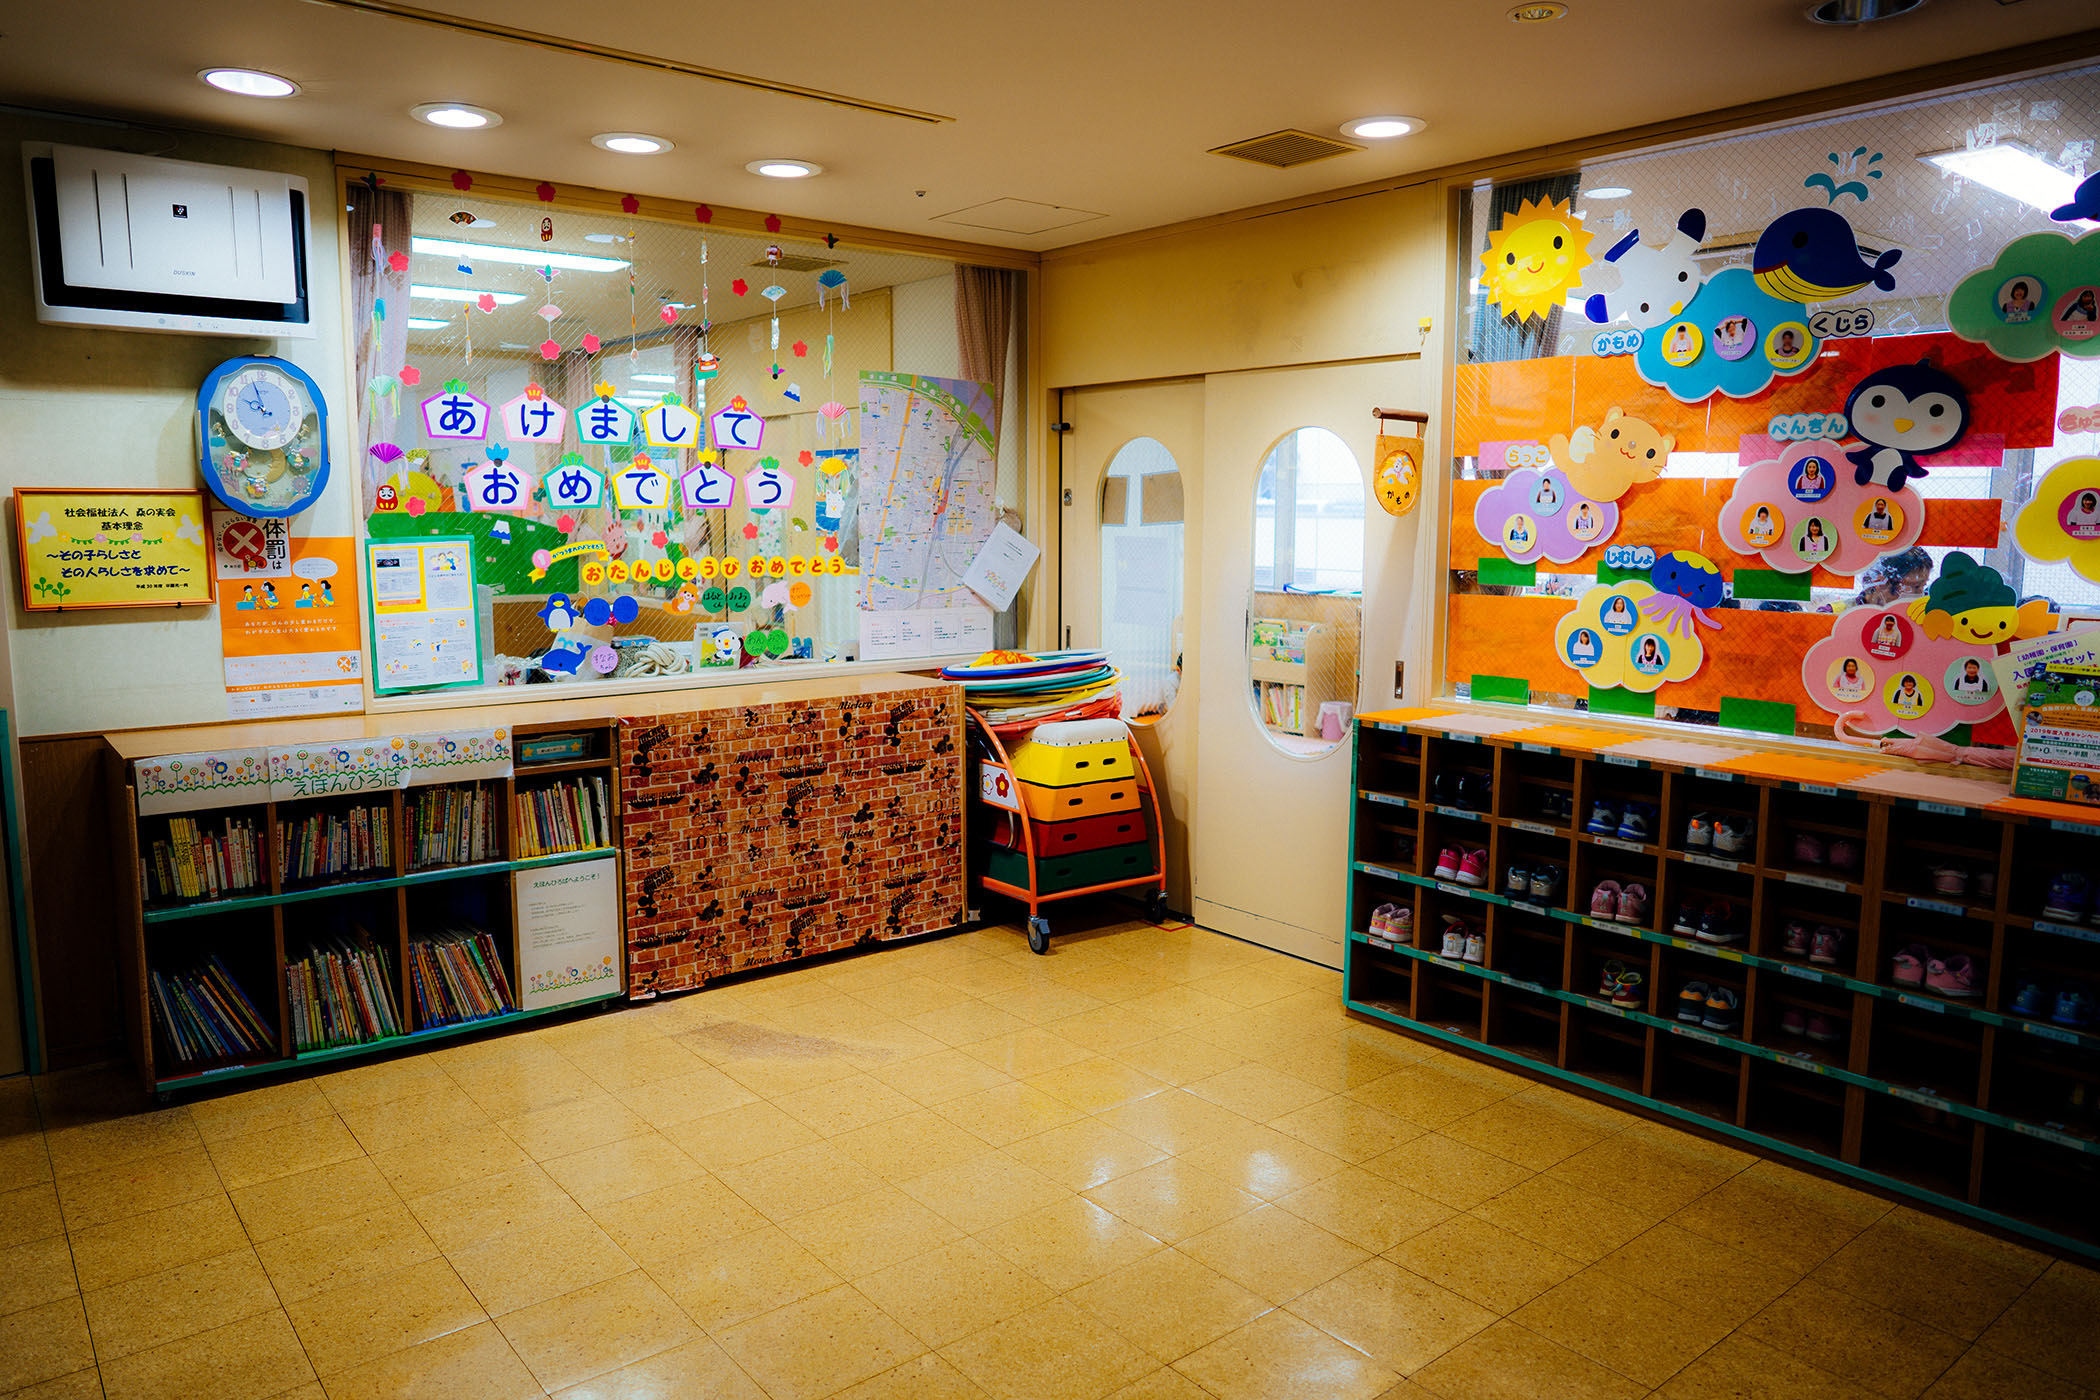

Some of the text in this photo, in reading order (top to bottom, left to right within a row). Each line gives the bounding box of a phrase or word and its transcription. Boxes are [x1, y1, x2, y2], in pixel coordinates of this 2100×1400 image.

[173, 269, 196, 277] DUSKIN
[1813, 313, 1869, 335] くじら
[1597, 333, 1640, 352] かもめ
[439, 394, 751, 445] あけまして
[1771, 416, 1845, 436] ぺんぎん
[1508, 449, 1546, 464] らっこ
[481, 467, 783, 505] おめでとう
[64, 507, 176, 518] 社会福祉法人 桑の実会
[101, 522, 144, 531] 基本理念
[262, 519, 286, 570] 体罰は
[1606, 548, 1653, 566] じむしょ
[586, 557, 842, 582] おたんじょうび おめでとう
[833, 699, 873, 711] Mickey
[729, 752, 773, 765] Mickey
[784, 743, 823, 761] LOE
[293, 770, 401, 797] えほんひろば
[927, 797, 961, 813] LOE
[937, 812, 961, 821] Micke
[738, 824, 771, 835] Mouse
[839, 829, 875, 840] Mickey
[688, 832, 729, 850] LOE
[888, 855, 922, 872] LOE
[788, 873, 825, 892] LOE
[737, 887, 776, 900] Mickey
